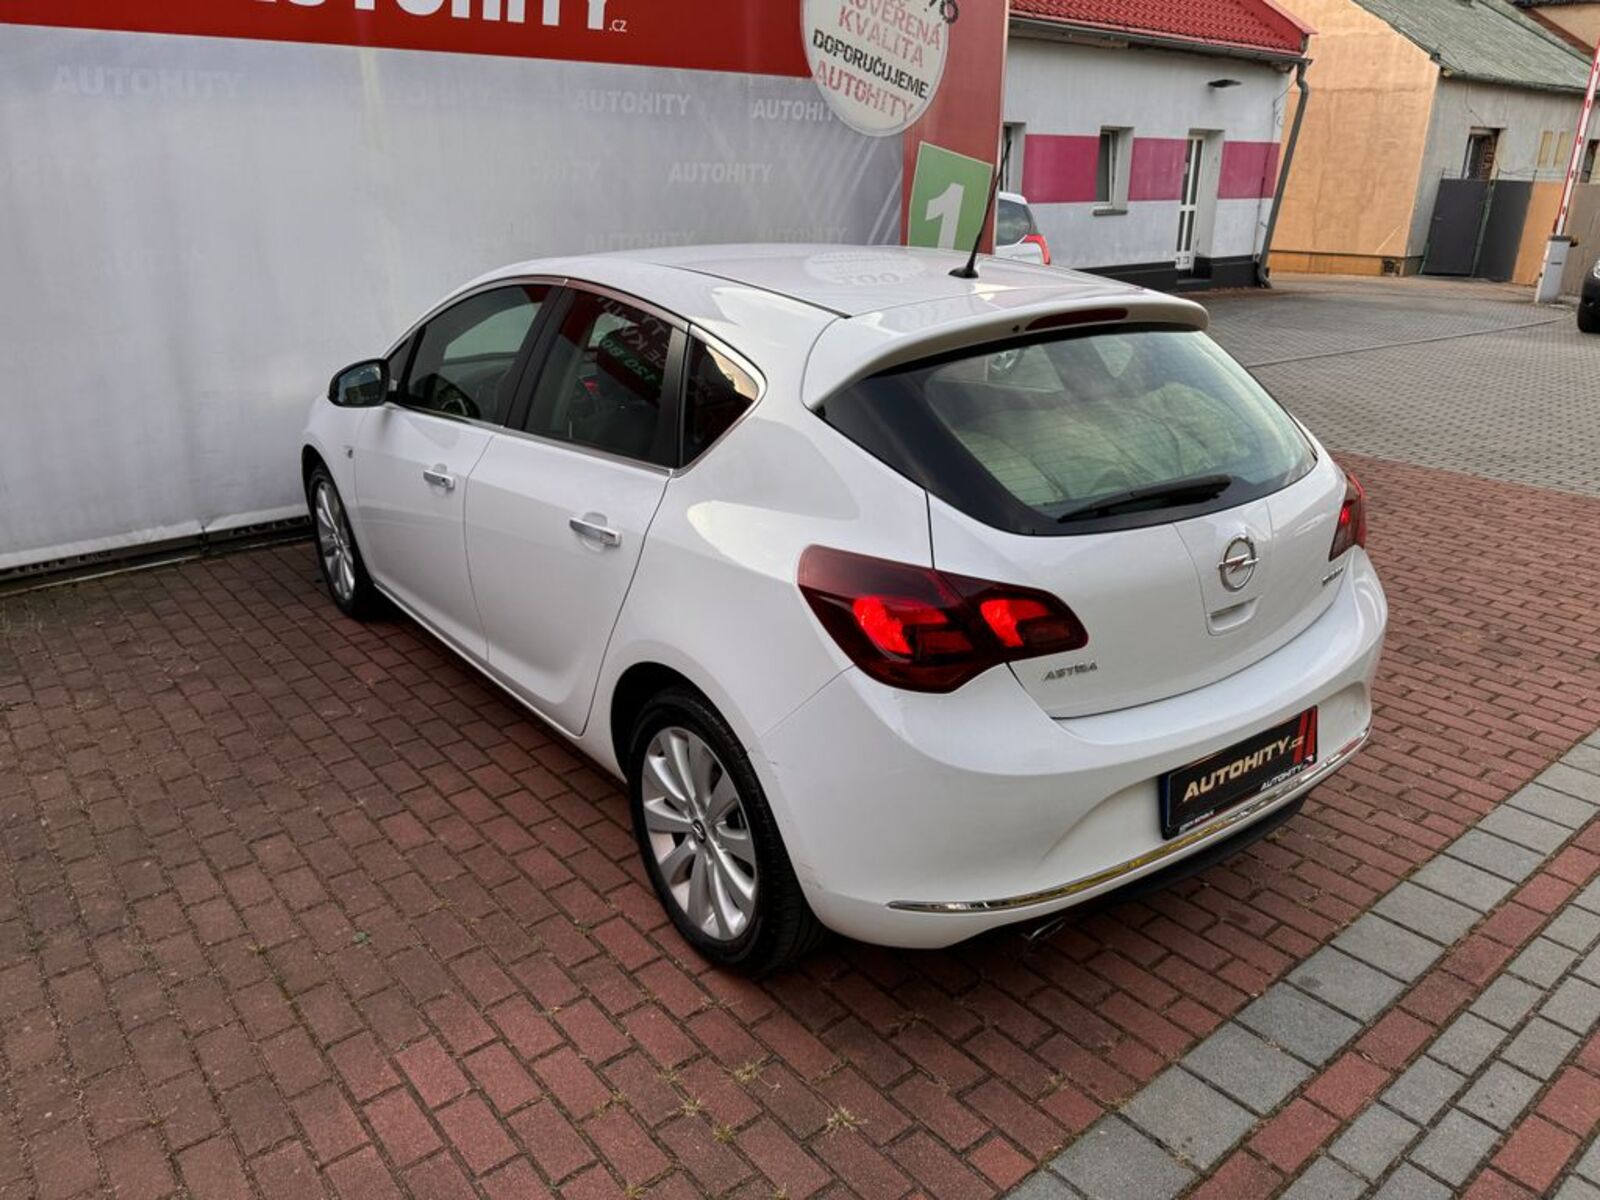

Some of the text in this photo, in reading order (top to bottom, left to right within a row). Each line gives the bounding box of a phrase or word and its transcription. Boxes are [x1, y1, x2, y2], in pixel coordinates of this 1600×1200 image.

[813, 28, 929, 100] DOPORUČUJEME
[839, 6, 923, 68] KVALITA
[574, 89, 691, 116] AUTOHITY
[752, 97, 834, 122] AUTOHI
[815, 60, 914, 122] AUTOHITY
[668, 161, 773, 184] AUTOHITY
[925, 183, 965, 249] 1
